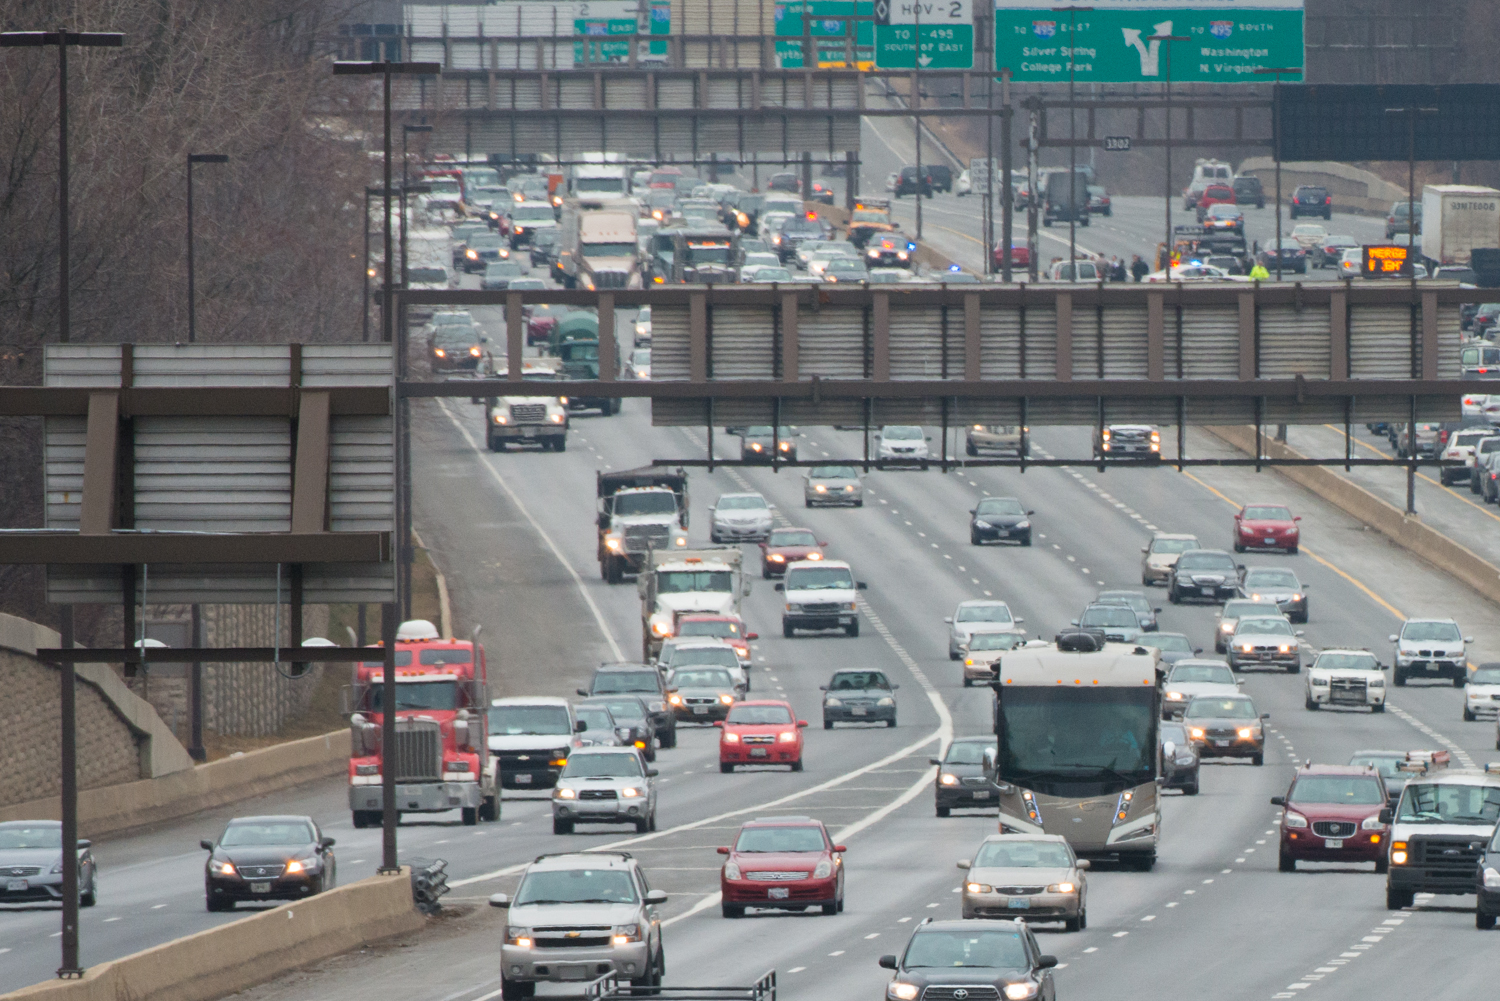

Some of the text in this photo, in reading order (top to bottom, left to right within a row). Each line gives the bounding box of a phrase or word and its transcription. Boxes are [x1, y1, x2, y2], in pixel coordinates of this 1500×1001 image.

[902, 5, 933, 15] HOV
[950, 3, 962, 18] 2
[894, 30, 910, 39] TO
[938, 44, 963, 52] EAST
[1022, 46, 1097, 59] Silver Spring
[1201, 48, 1269, 59] Washington
[1021, 62, 1093, 74] College Park
[1368, 247, 1407, 259] MERGE
